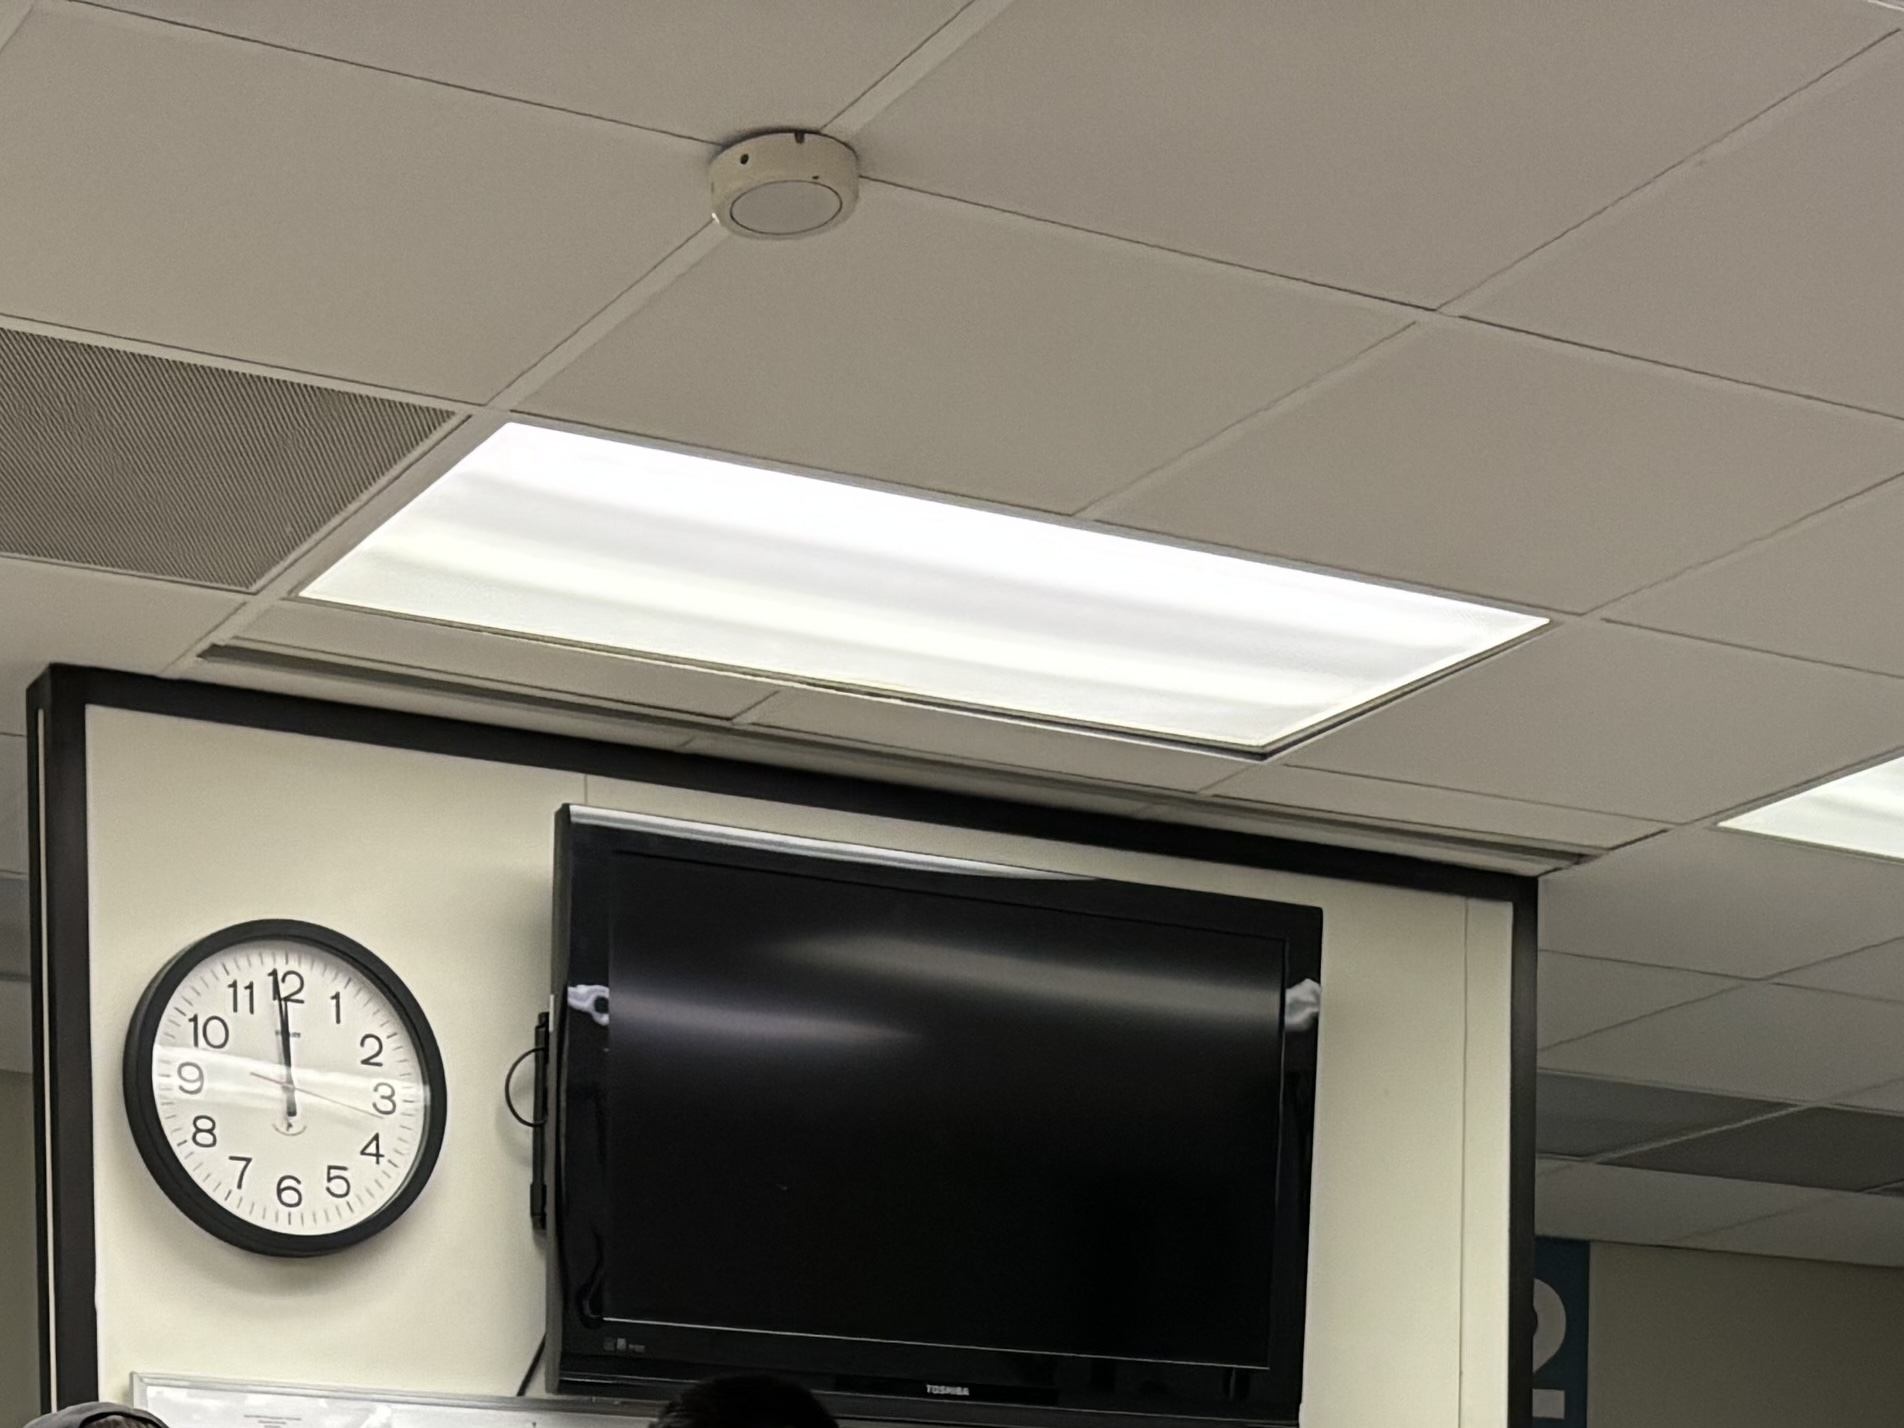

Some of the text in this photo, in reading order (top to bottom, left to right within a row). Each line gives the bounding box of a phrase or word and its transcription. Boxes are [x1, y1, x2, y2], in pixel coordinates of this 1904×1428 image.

[227, 979, 254, 1015] 11
[267, 968, 305, 1004] 12
[330, 991, 342, 1025] 1
[188, 1013, 230, 1049] 10
[359, 1033, 384, 1067] 2
[177, 1061, 205, 1095] 9
[372, 1082, 397, 1116] 3
[191, 1115, 217, 1149] 8
[359, 1132, 385, 1165] 4
[228, 1155, 253, 1190] 7
[325, 1165, 352, 1199] 5
[276, 1174, 303, 1208] 6
